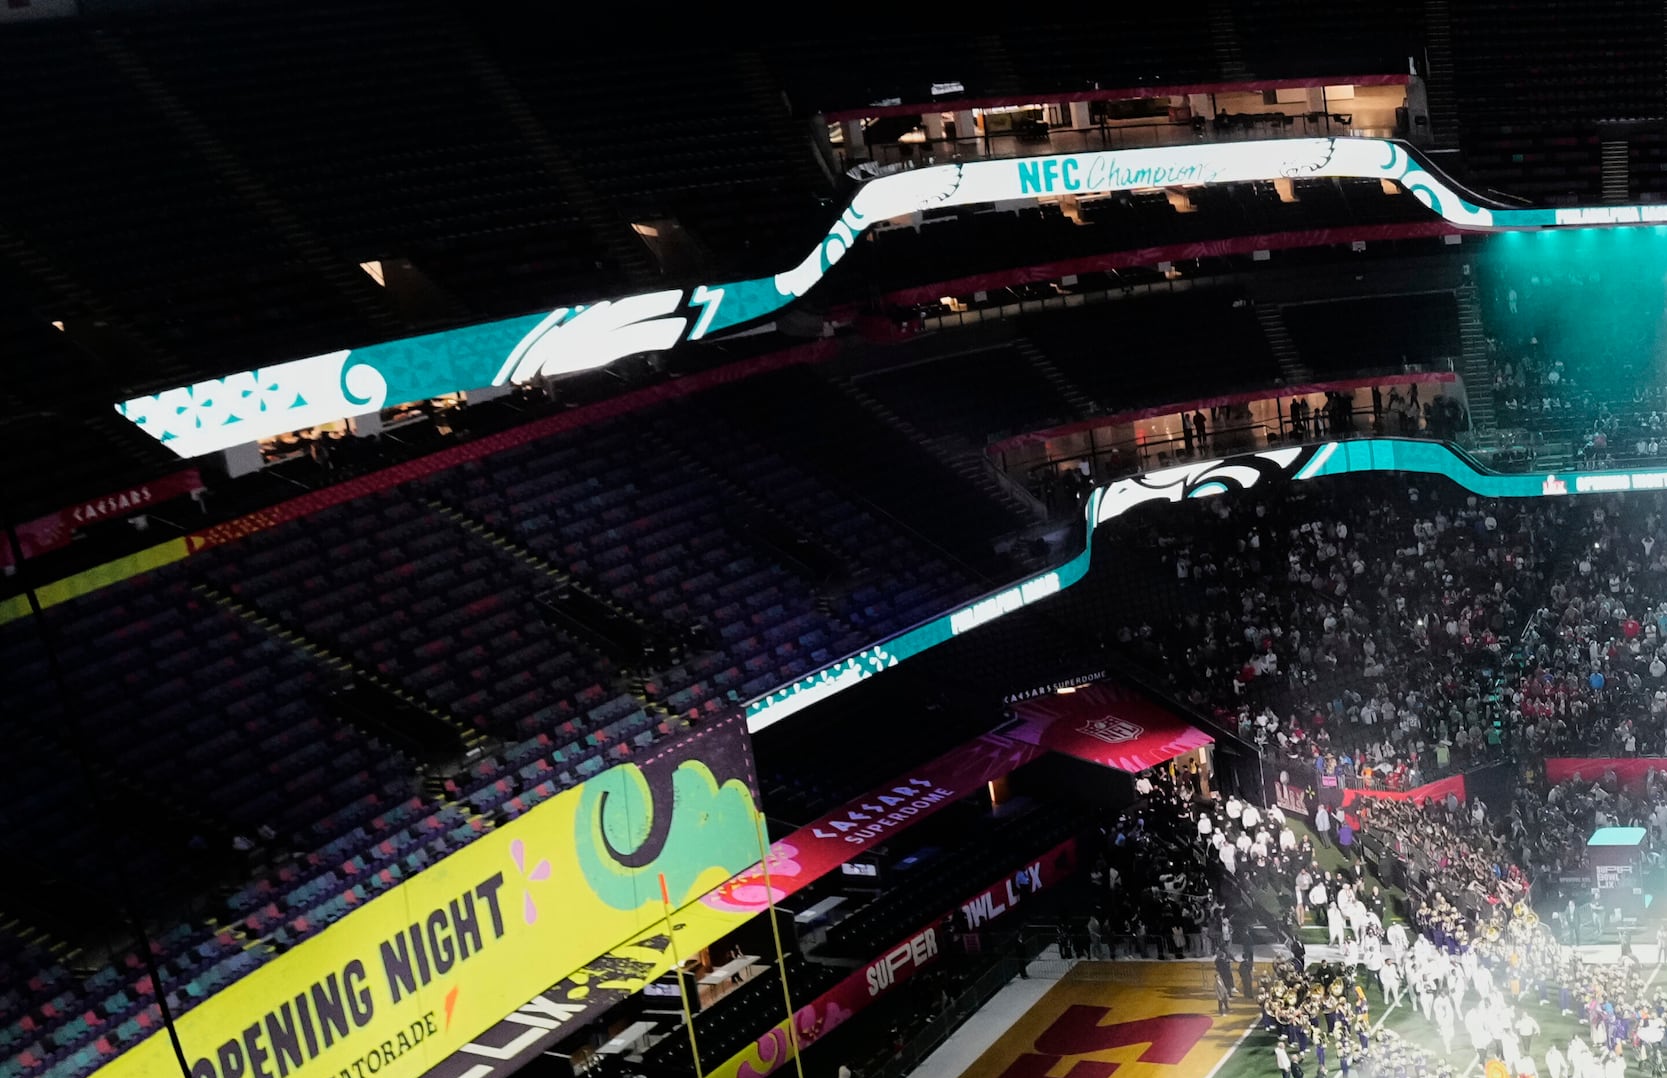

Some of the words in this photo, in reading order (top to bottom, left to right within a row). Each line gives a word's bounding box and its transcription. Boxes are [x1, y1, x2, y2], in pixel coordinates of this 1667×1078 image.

[1018, 158, 1080, 193] NFC
[73, 486, 152, 522] CAESARS
[1004, 685, 1051, 704] CAESARS
[1053, 670, 1106, 690] SUPERDOME
[1104, 722, 1137, 743] NFL
[812, 777, 931, 839] CAESARS
[844, 788, 954, 845] SUPERDOME
[379, 871, 504, 1005] NIGHT
[866, 928, 938, 997] SUPER
[1006, 862, 1043, 906] LX
[460, 994, 587, 1060] LIX
